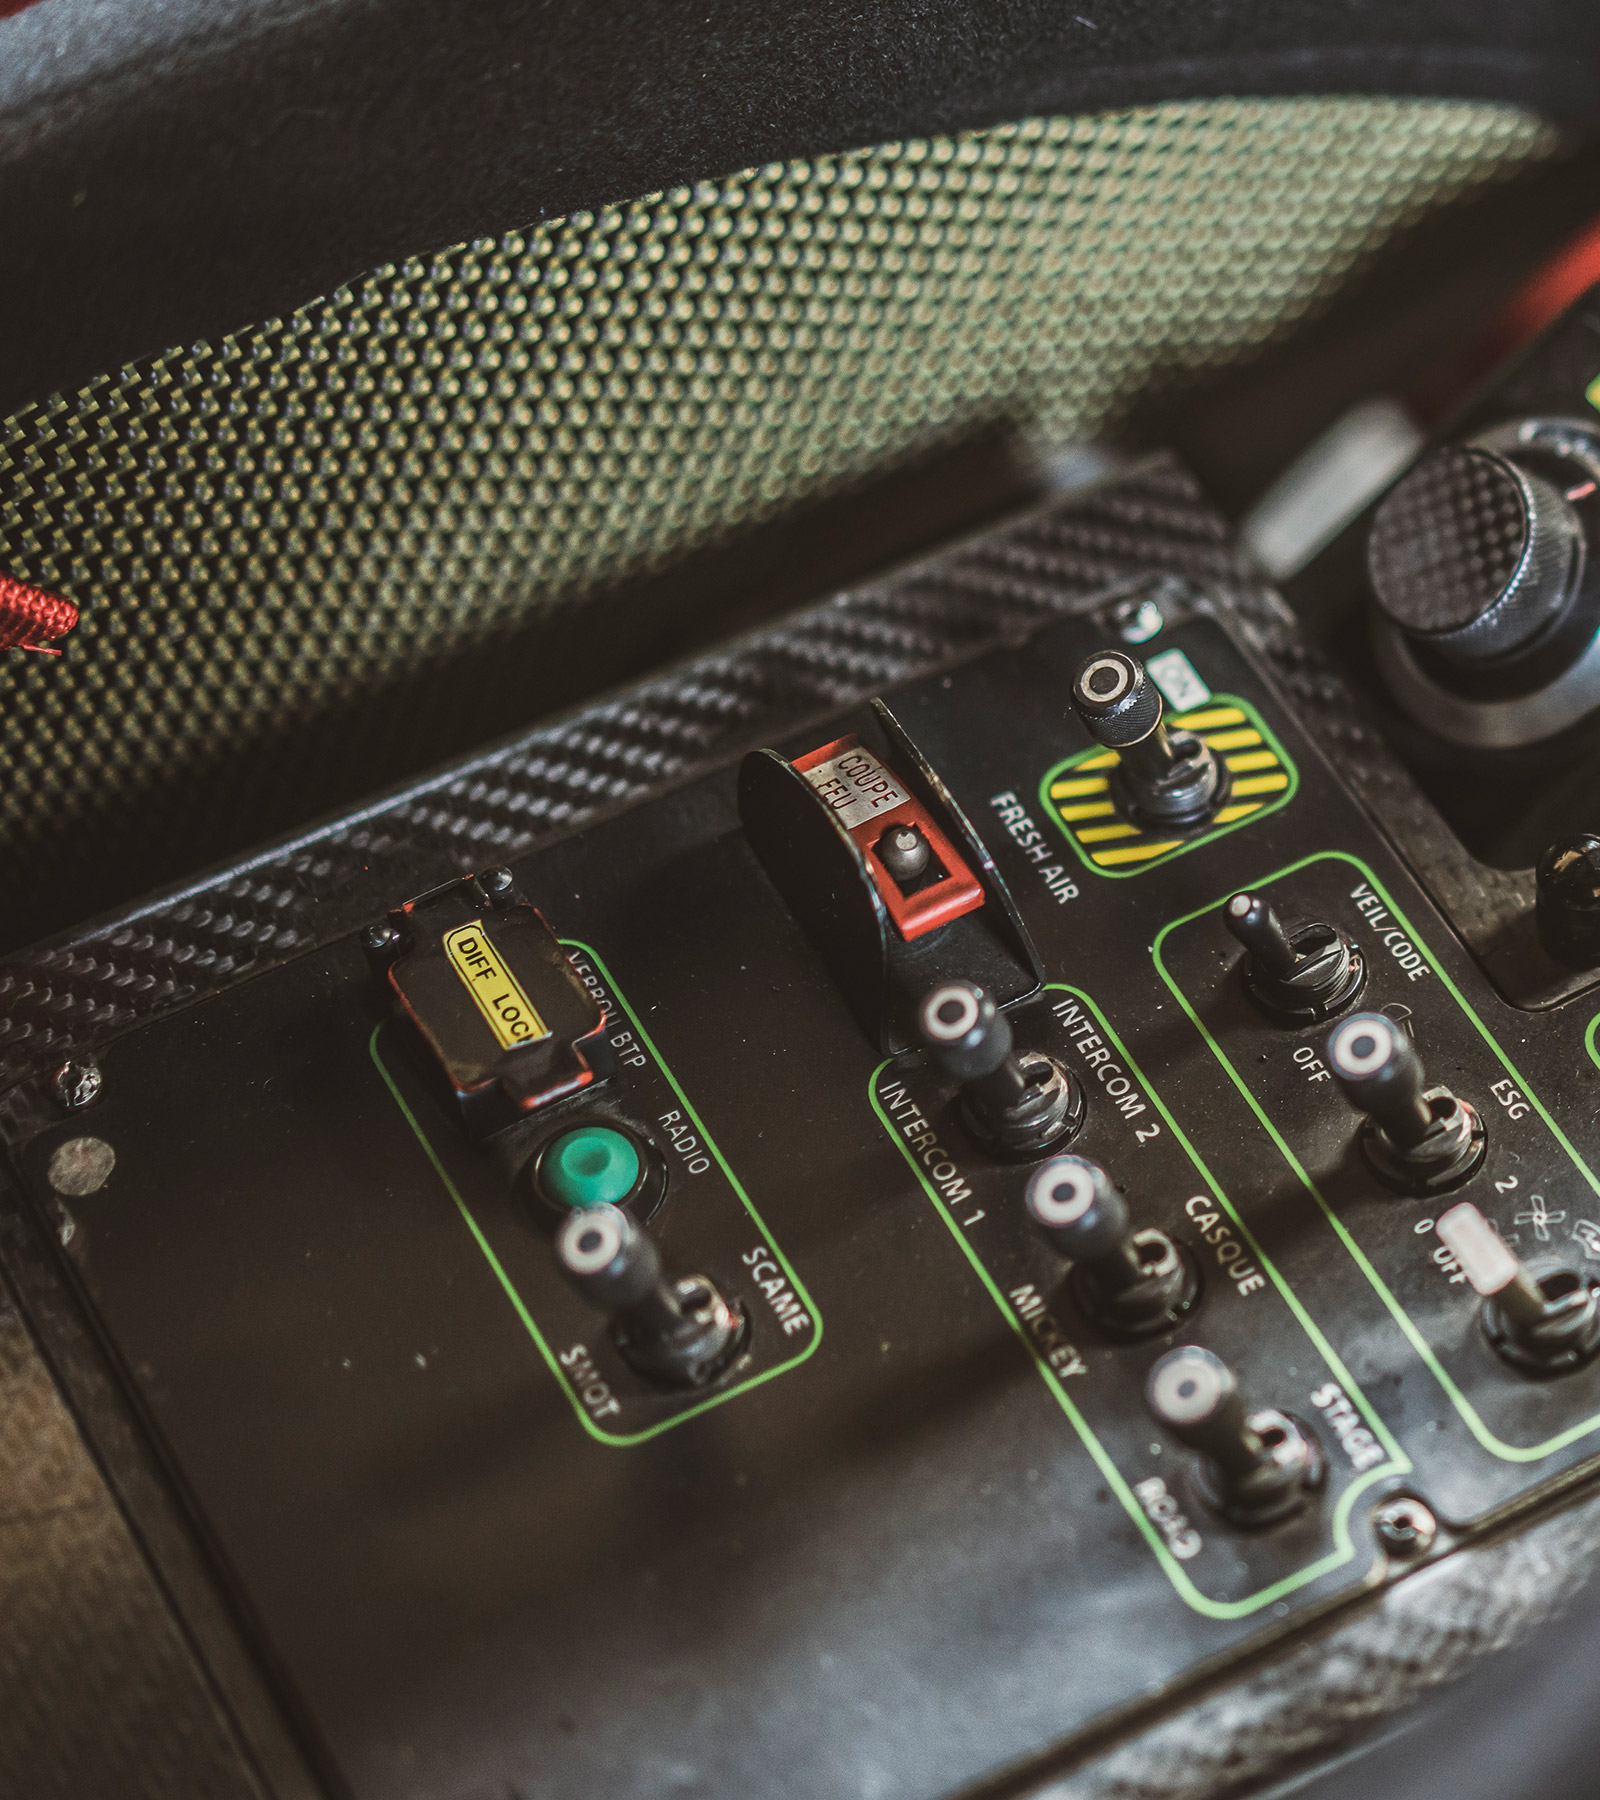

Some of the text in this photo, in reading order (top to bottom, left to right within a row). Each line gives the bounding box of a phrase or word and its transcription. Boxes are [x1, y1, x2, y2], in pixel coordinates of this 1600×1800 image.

[815, 777, 859, 812] FEU
[837, 753, 899, 810] COUPE
[990, 792, 1080, 905] FRESH AIR
[457, 936, 497, 981] DIFF
[1349, 882, 1431, 983] VEIL/CODE
[609, 1031, 647, 1069] BTP
[1051, 998, 1160, 1144] INTERCOM 2
[1292, 1046, 1331, 1084] OFF
[1489, 1078, 1531, 1121] ESG
[658, 1109, 710, 1175] RADIO
[879, 1080, 986, 1227] INTERCOM 1
[1494, 1175, 1519, 1194] 2
[1184, 1195, 1267, 1297] CASQUE
[743, 1246, 811, 1336] SCAME
[1009, 1283, 1089, 1380] MICKEY
[1310, 1382, 1386, 1472] STAGE
